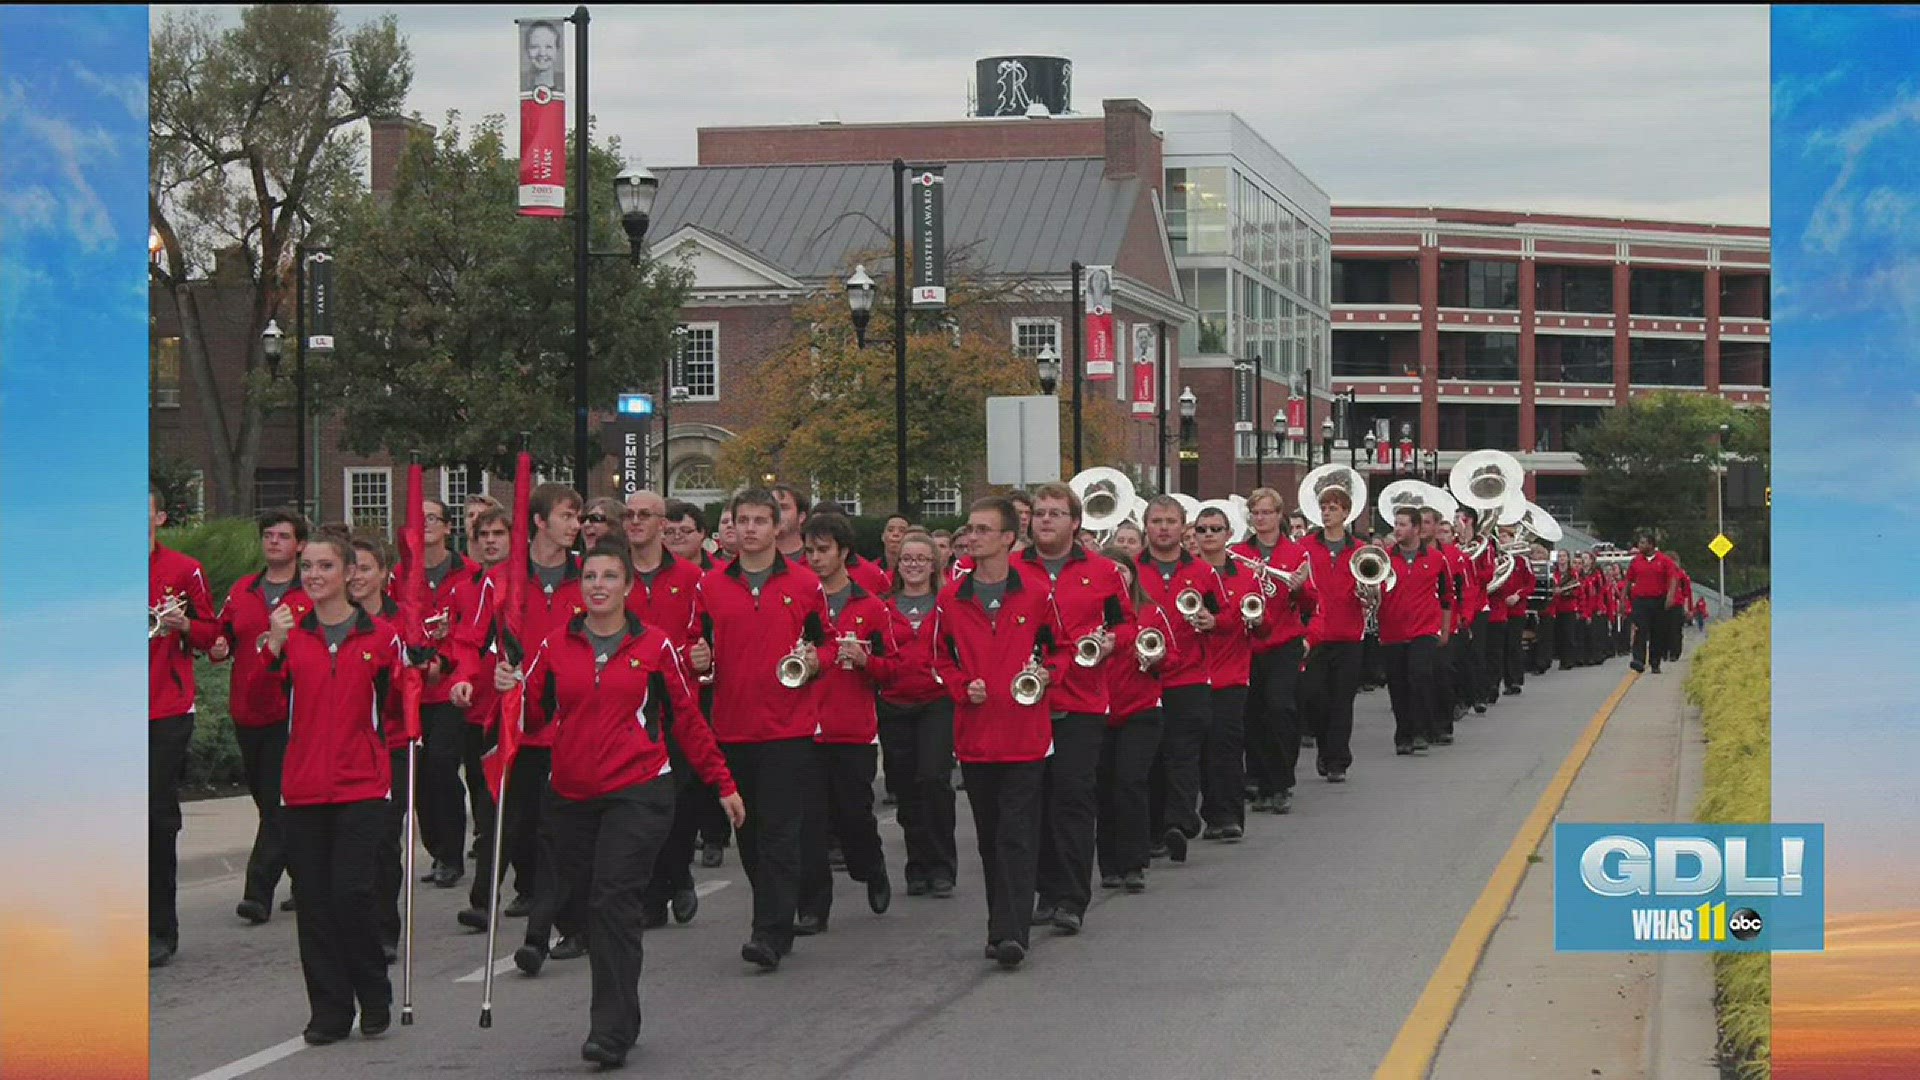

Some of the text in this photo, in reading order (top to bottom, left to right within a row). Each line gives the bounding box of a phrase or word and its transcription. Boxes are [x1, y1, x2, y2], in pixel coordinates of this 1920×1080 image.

[541, 148, 553, 179] Wise
[924, 189, 933, 283] TRUSTEES AWARD
